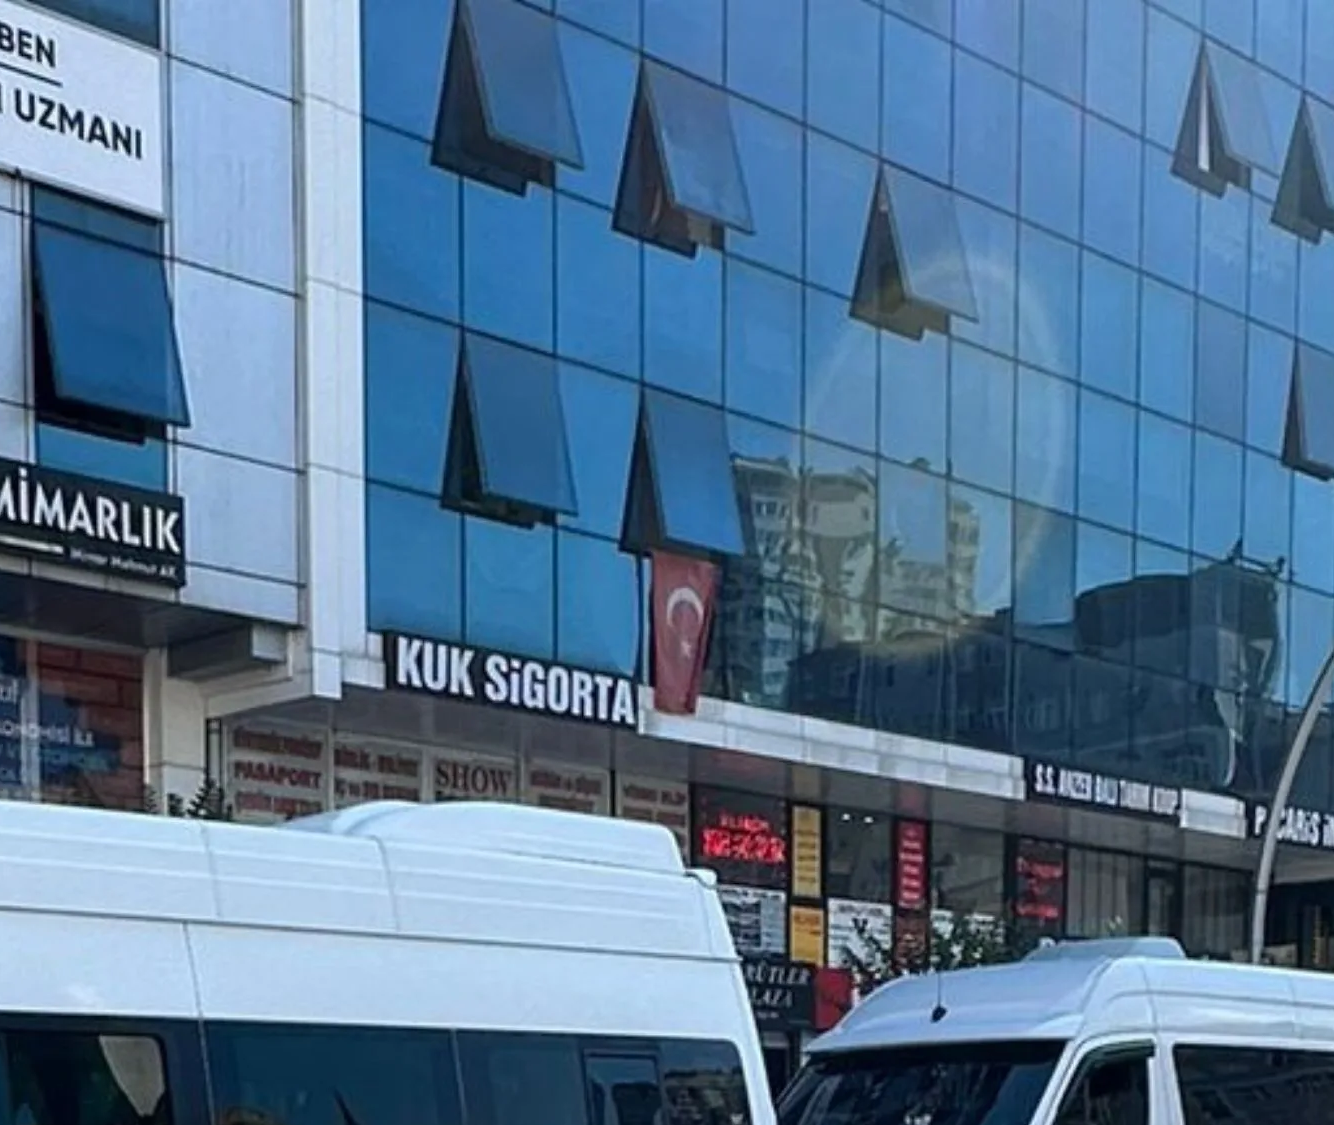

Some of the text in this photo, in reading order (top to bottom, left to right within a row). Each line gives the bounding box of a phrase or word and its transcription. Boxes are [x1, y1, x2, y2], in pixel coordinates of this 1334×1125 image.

[13, 87, 143, 159] UZMANI
[397, 635, 476, 698] KUK
[435, 756, 512, 797] SHOW
